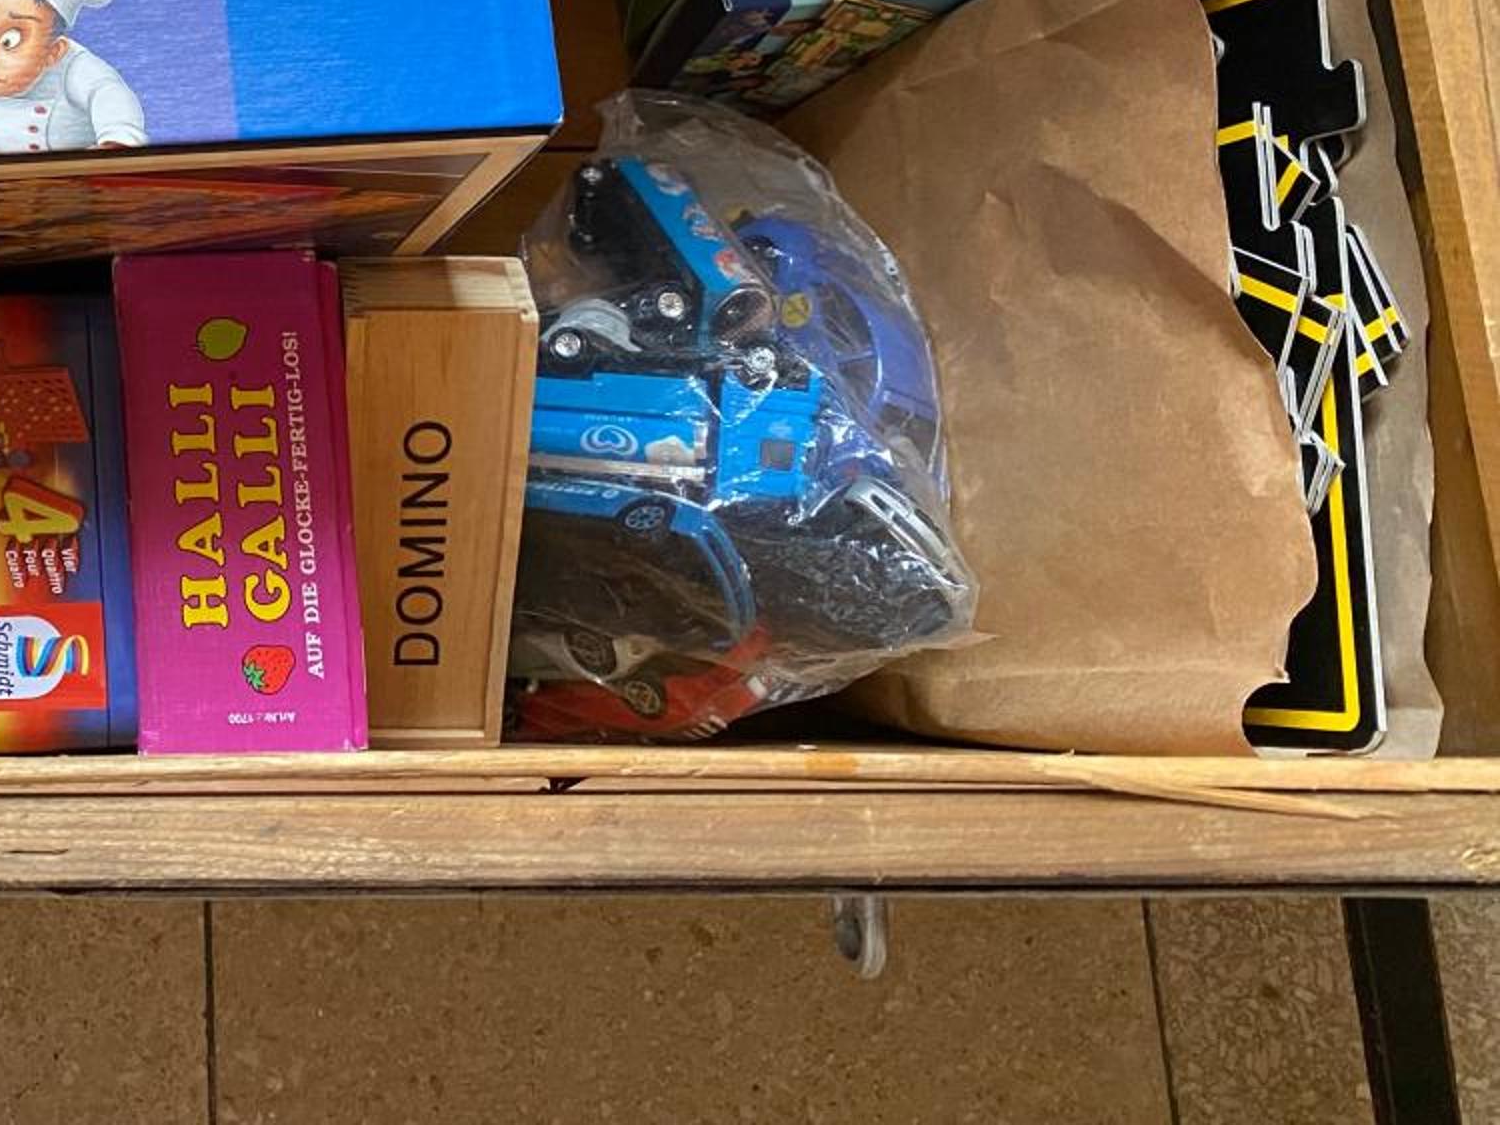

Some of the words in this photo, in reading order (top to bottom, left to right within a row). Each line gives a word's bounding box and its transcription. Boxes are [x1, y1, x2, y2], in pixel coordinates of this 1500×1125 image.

[282, 330, 317, 575] GLOCKE-FERTIG-LOS!
[168, 383, 229, 630] HALLI
[230, 384, 293, 623] GALLI
[22, 549, 40, 577] Four
[61, 548, 77, 573] Vier
[393, 420, 453, 667] DOMINO
[5, 549, 25, 588] Cuatro
[301, 582, 321, 625] DIE
[305, 632, 325, 680] AUF
